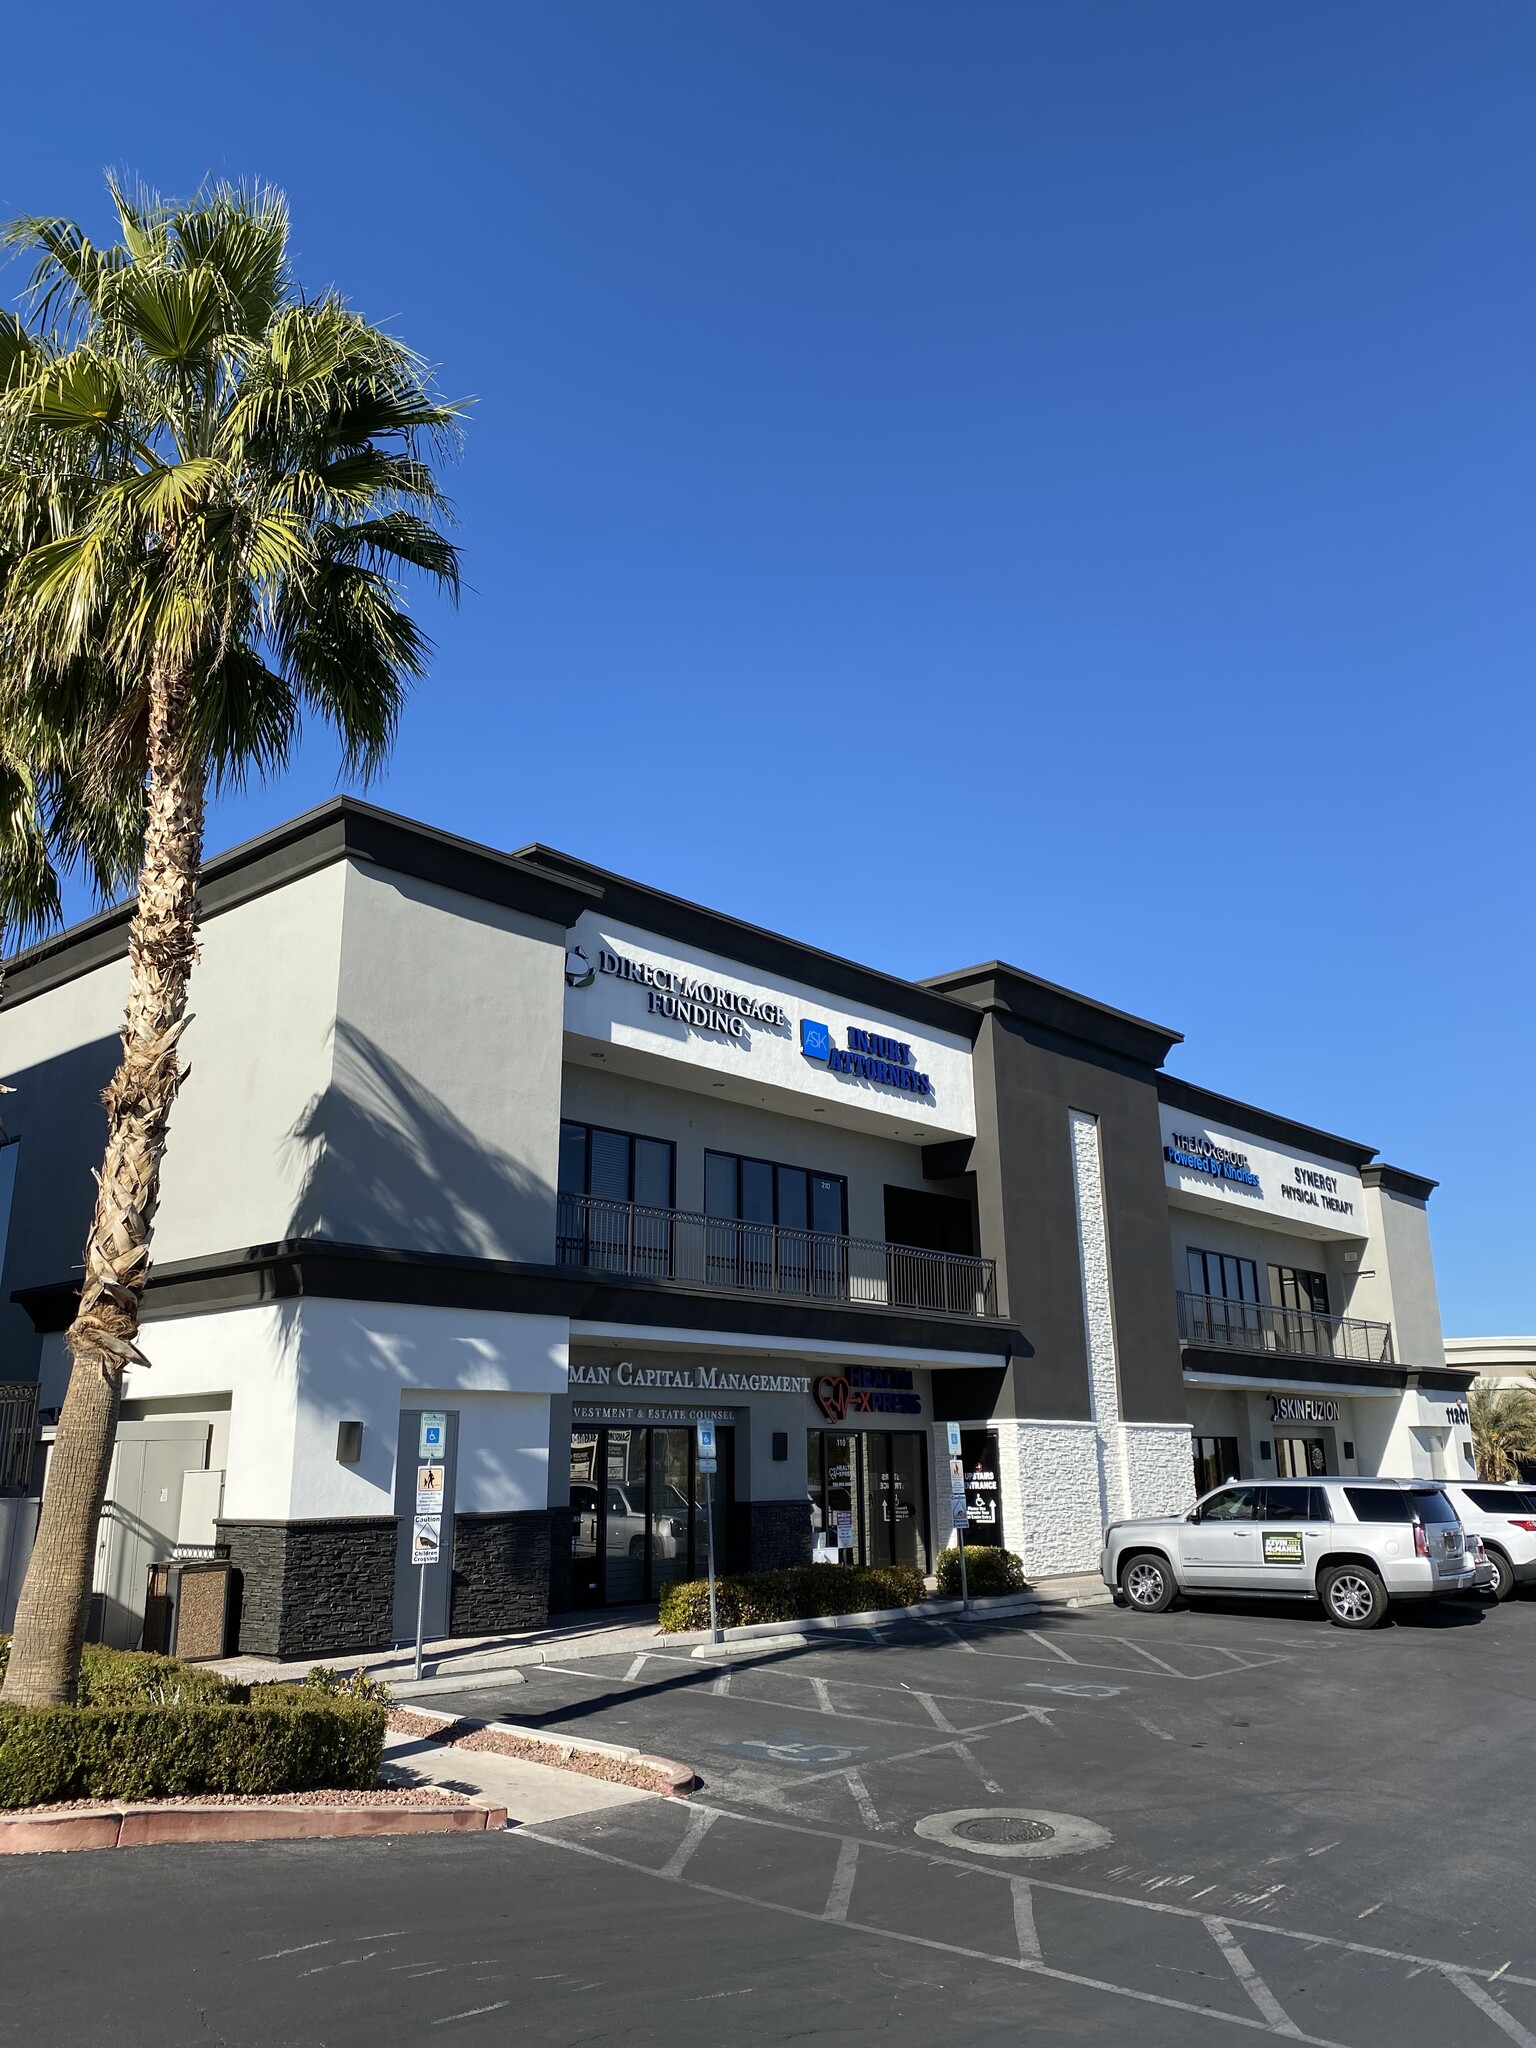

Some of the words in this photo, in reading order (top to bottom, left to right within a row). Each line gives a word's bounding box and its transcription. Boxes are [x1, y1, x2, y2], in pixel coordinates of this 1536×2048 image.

[599, 950, 679, 993] DIRECT
[679, 976, 785, 1027] MORTGAGE
[648, 991, 743, 1037] FUNDING
[805, 1029, 828, 1051] ASK
[847, 1026, 911, 1065] INJURY
[827, 1048, 930, 1095] ATTORNEYS
[1165, 1146, 1210, 1173] Powered
[1211, 1159, 1222, 1178] By
[1222, 1162, 1260, 1187] Kindness
[1294, 1166, 1337, 1194] SYNERGY
[1281, 1184, 1319, 1208] PHYSICAL
[1321, 1194, 1353, 1216] THERAPY
[617, 1361, 694, 1388] CAPITAL
[697, 1366, 811, 1393] MANAGEMENT
[636, 1410, 645, 1418] &
[648, 1409, 686, 1419] ESTATE
[689, 1410, 735, 1420] COUNSEL
[1446, 1407, 1469, 1425] 11201
[964, 1471, 994, 1481] UPSTAIRS
[964, 1481, 997, 1489] ENTRANCE
